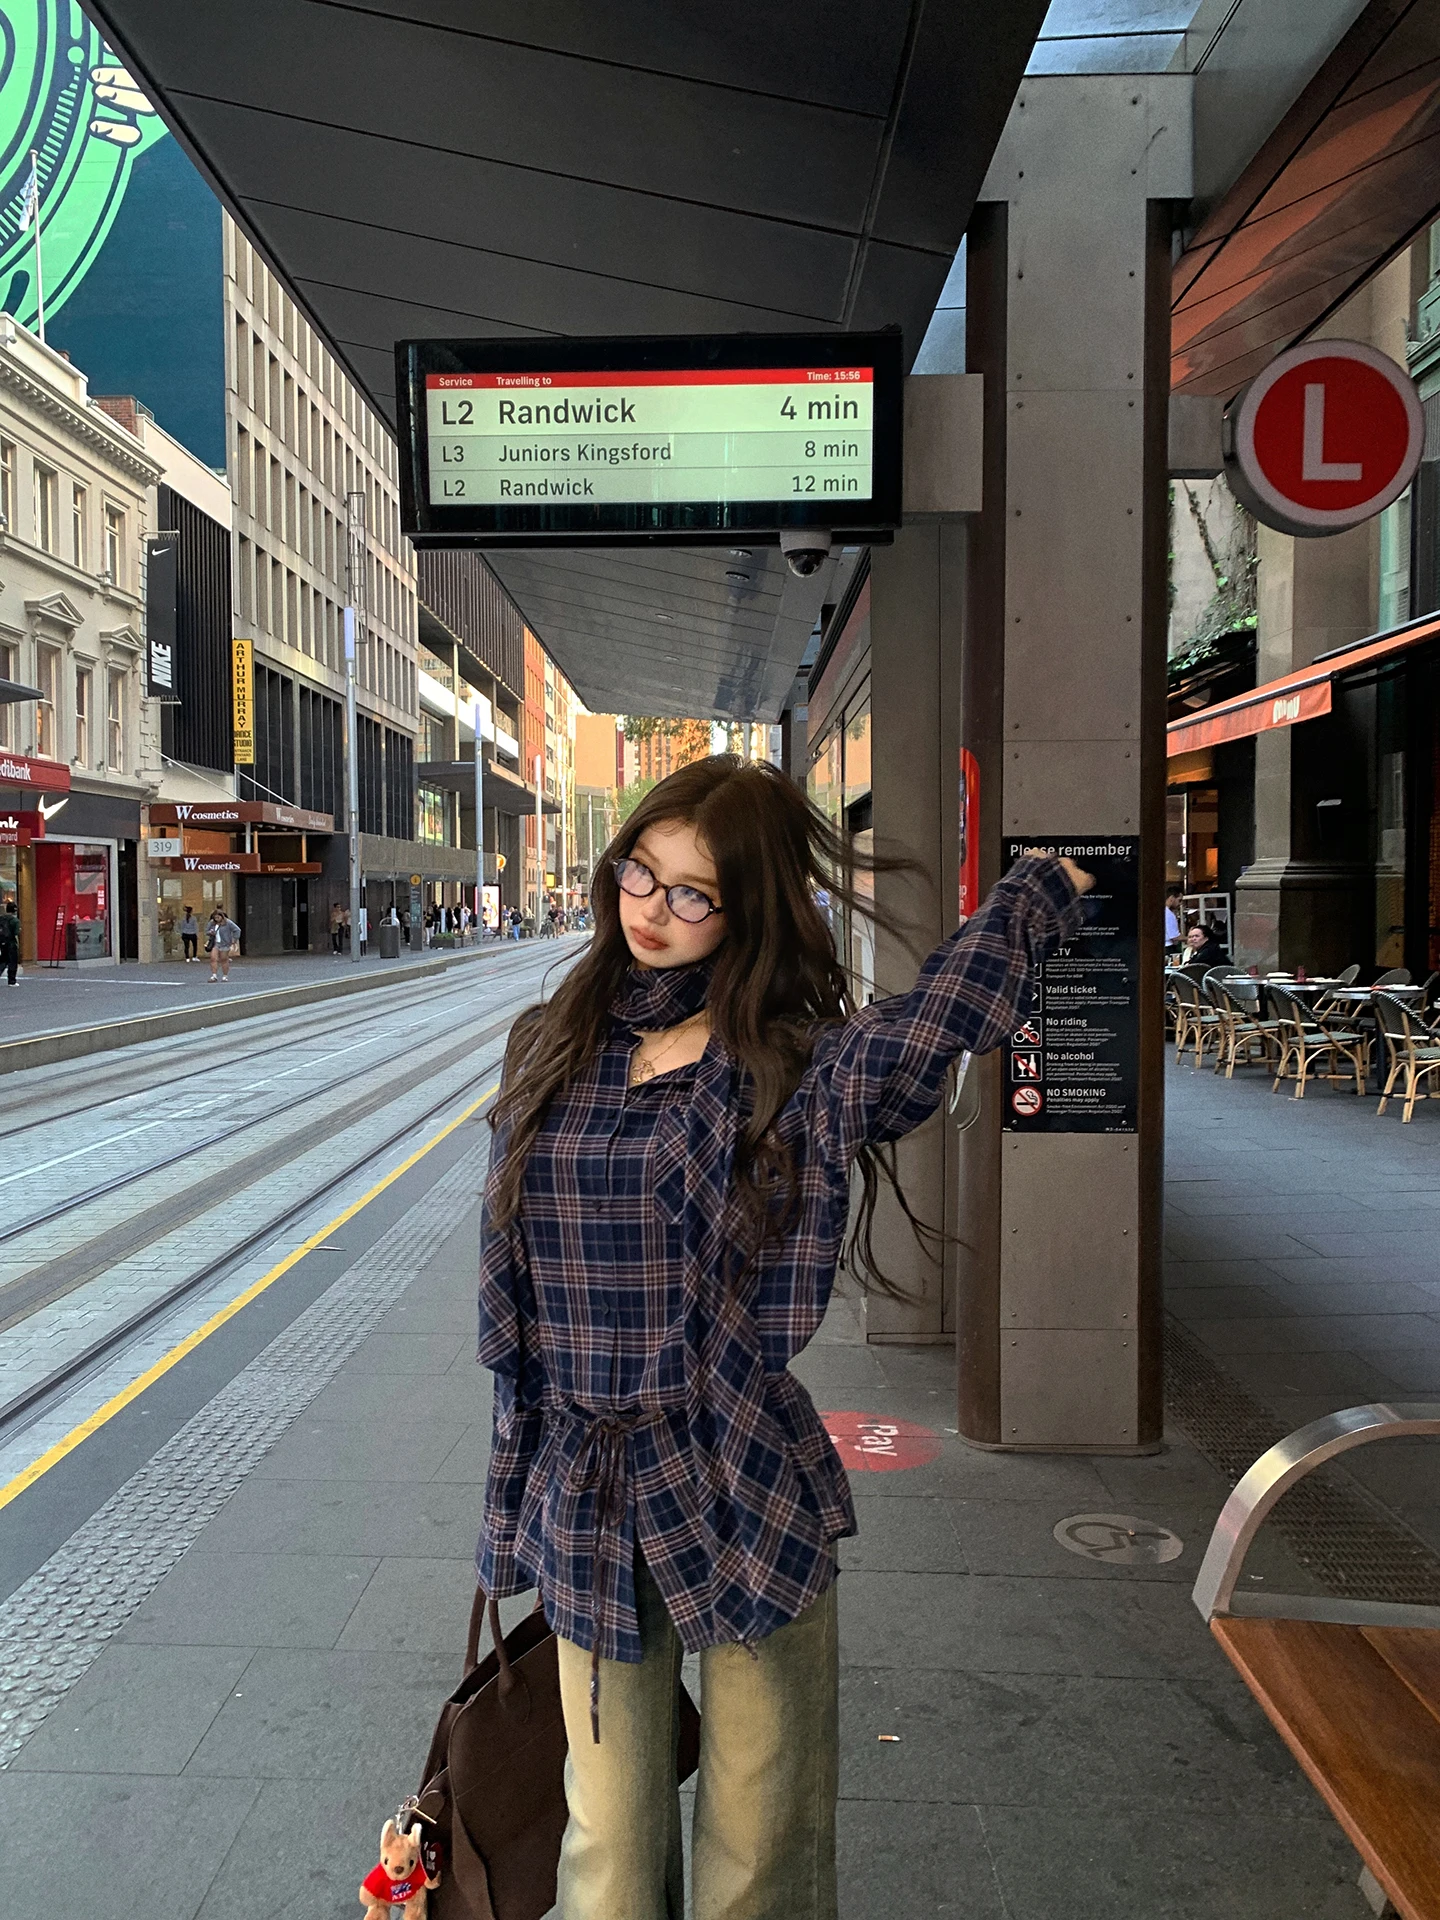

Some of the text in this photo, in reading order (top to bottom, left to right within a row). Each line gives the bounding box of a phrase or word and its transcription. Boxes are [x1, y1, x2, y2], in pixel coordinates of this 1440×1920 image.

[439, 371, 861, 388] Service Travelling to Time: 15:56
[442, 394, 859, 425] L2 Randwick 4 min
[1302, 383, 1363, 481] L
[442, 440, 858, 465] L3 Juniors Kingsford 8 min
[443, 474, 858, 497] L2 Randwick 12 min
[151, 640, 172, 689] NIKE
[236, 643, 246, 684] ARTHUR
[237, 686, 246, 728] MURRAY
[153, 841, 172, 853] 319
[1010, 843, 1132, 856] Plese remember
[1046, 985, 1097, 994] Valid ticket
[1046, 1017, 1088, 1028] No riding
[1046, 1052, 1094, 1060] No alcohol
[1046, 1088, 1106, 1097] NO SMOKING
[853, 1424, 899, 1457] Pay
